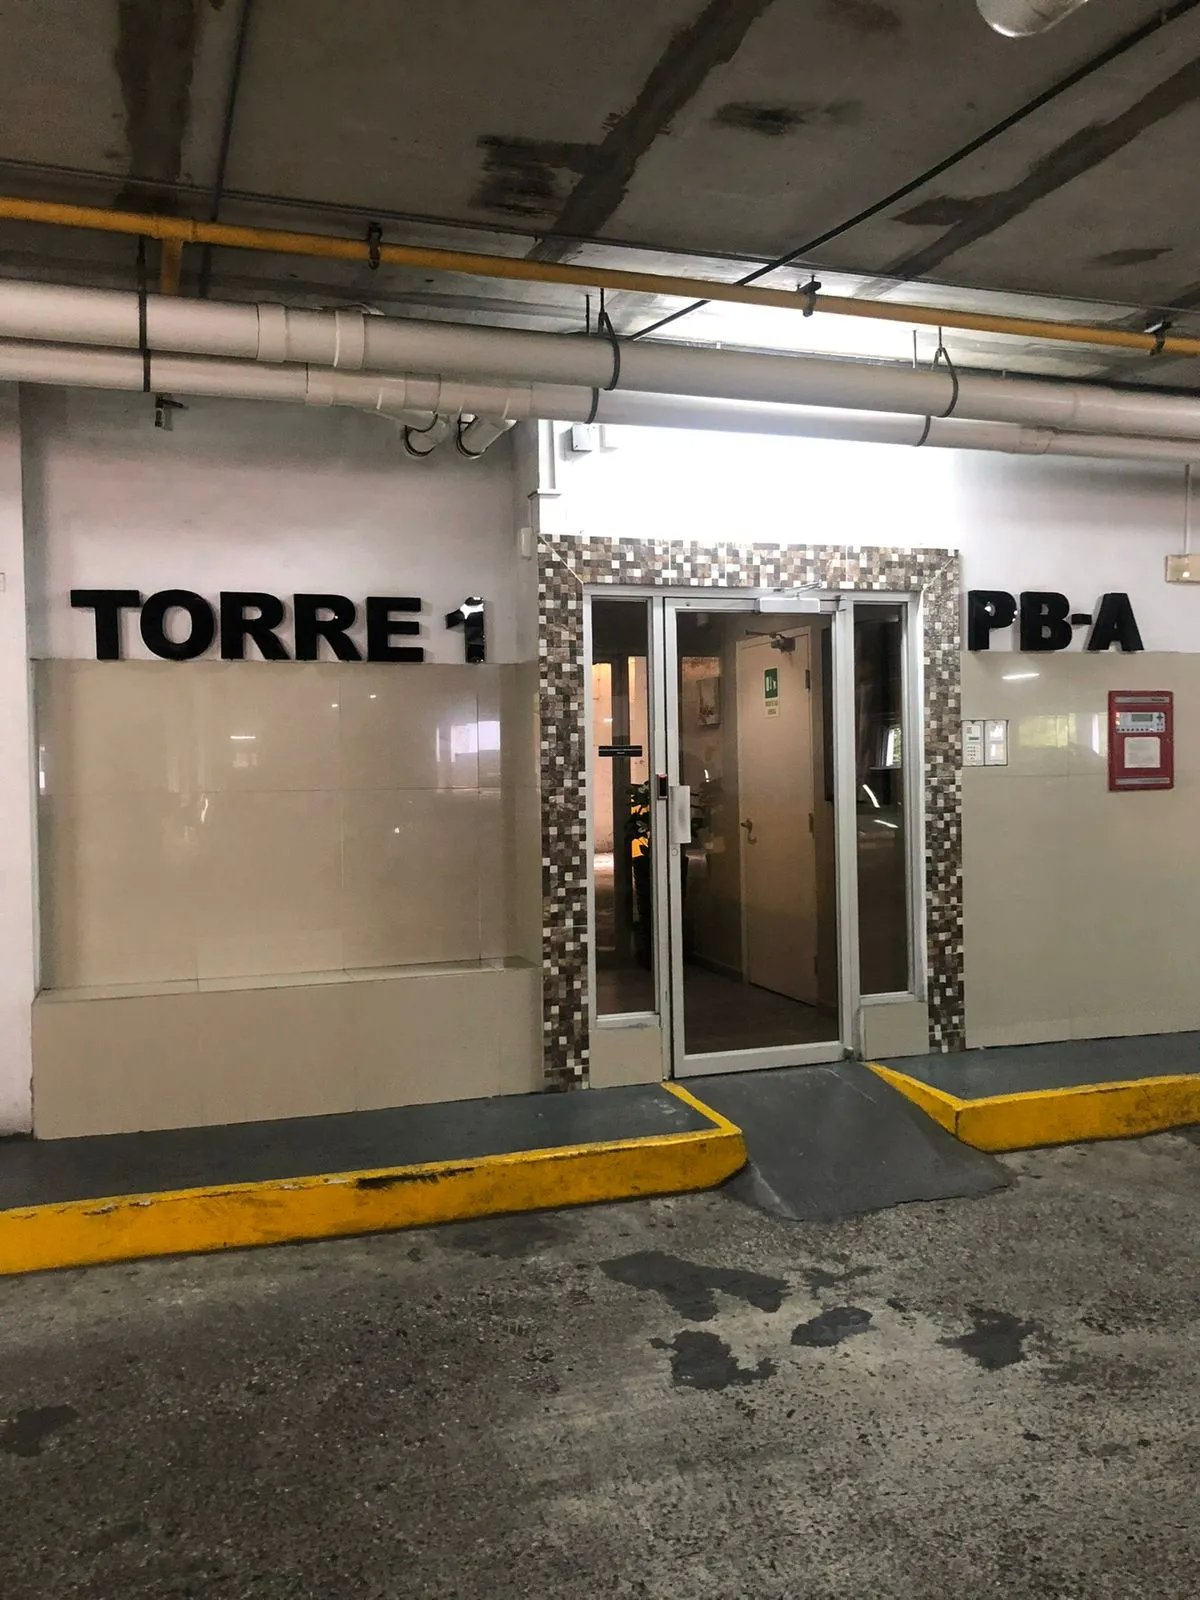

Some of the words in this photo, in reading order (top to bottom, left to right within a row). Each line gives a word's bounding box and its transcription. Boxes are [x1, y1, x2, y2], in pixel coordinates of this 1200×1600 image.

[70, 589, 424, 662] TORRE
[445, 596, 487, 663] 1
[968, 590, 1145, 652] PB-A
